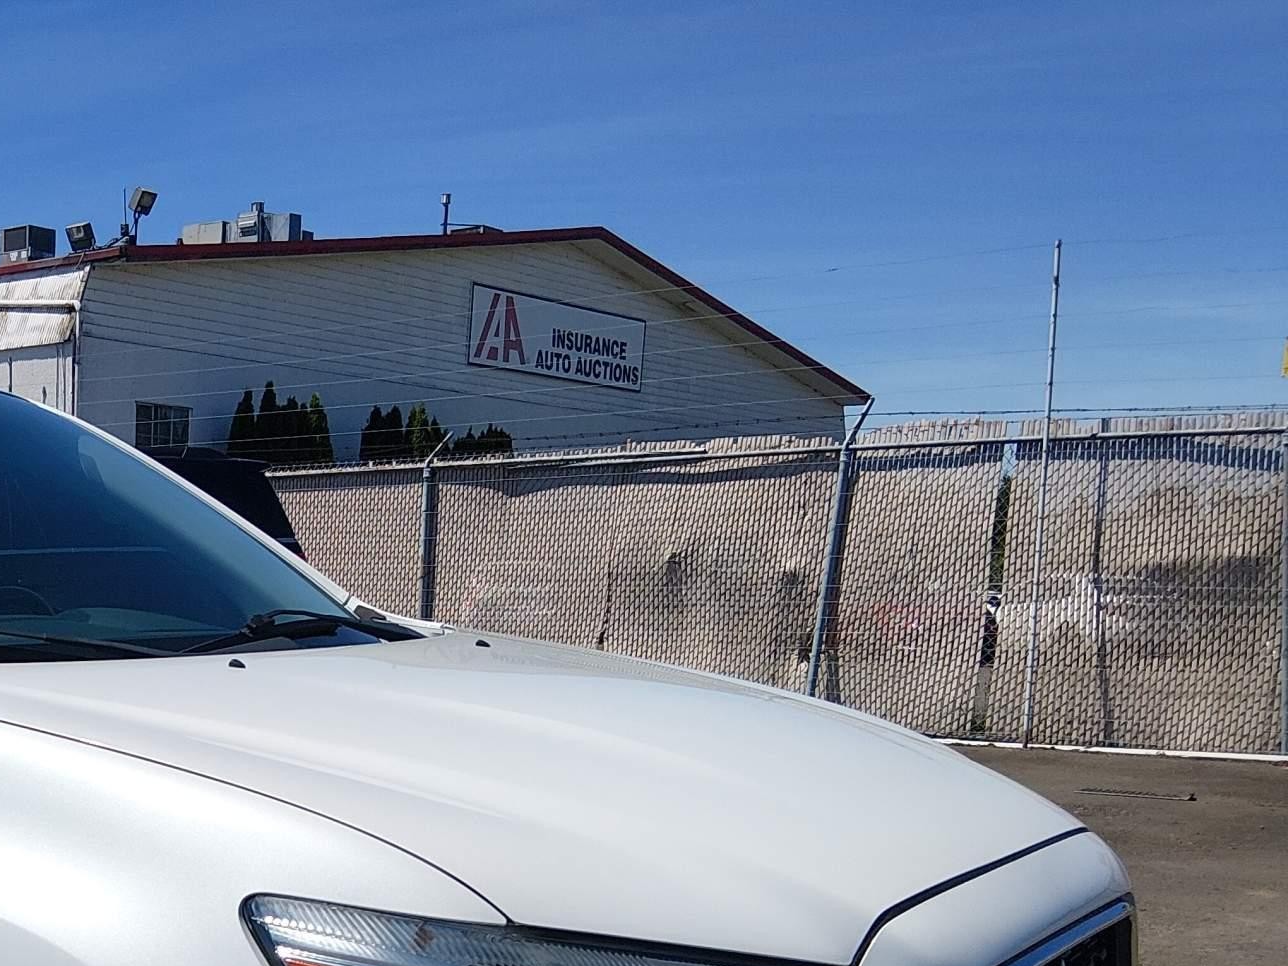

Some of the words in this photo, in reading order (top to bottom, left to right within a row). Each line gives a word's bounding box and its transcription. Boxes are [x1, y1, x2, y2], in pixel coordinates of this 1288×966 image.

[551, 328, 628, 361] INSURANCE
[534, 350, 572, 374] AUTO
[574, 356, 640, 385] AUCTIONS
